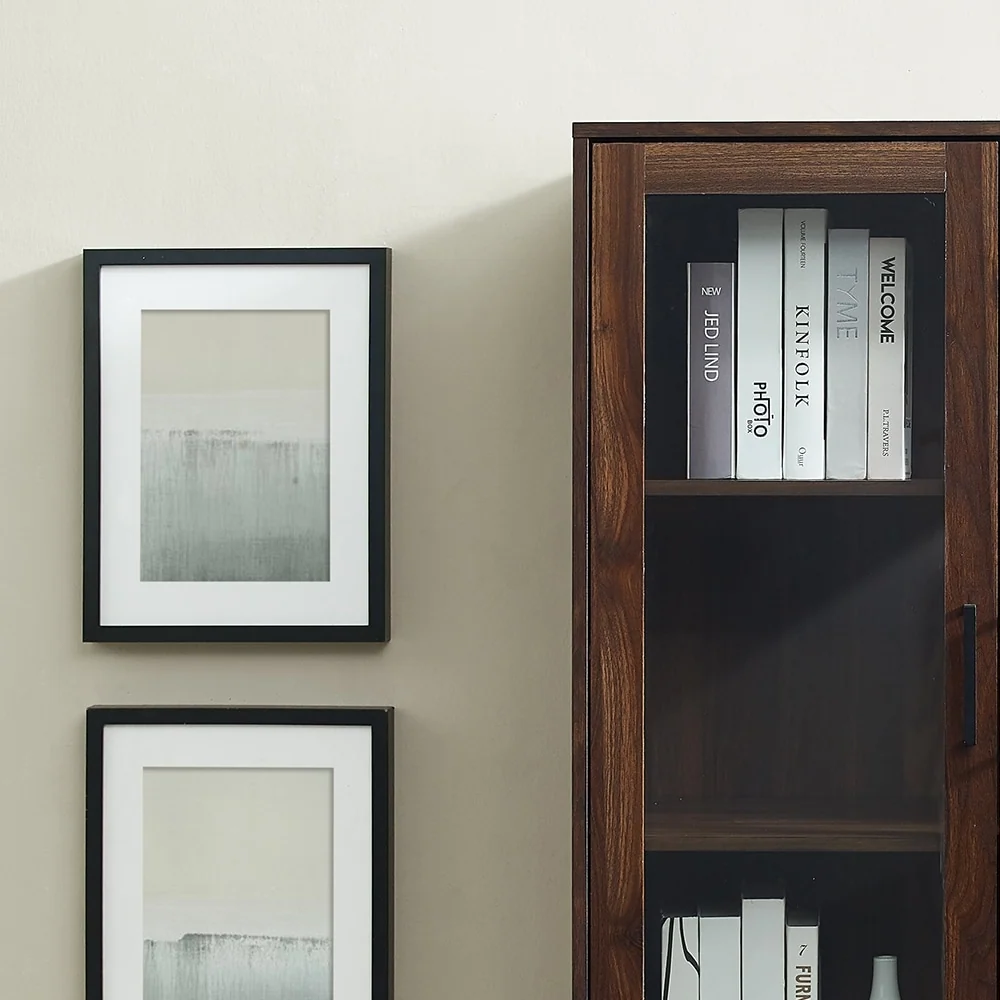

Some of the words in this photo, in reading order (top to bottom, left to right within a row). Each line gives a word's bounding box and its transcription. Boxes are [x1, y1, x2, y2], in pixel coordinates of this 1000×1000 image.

[701, 286, 722, 296] NEW
[836, 267, 859, 339] TYME
[880, 256, 896, 344] WELCOME
[704, 310, 720, 340] JED
[704, 344, 720, 382] LIND
[794, 304, 810, 408] KINFOLK
[753, 381, 771, 438] PHOTO
[798, 944, 808, 957] 7
